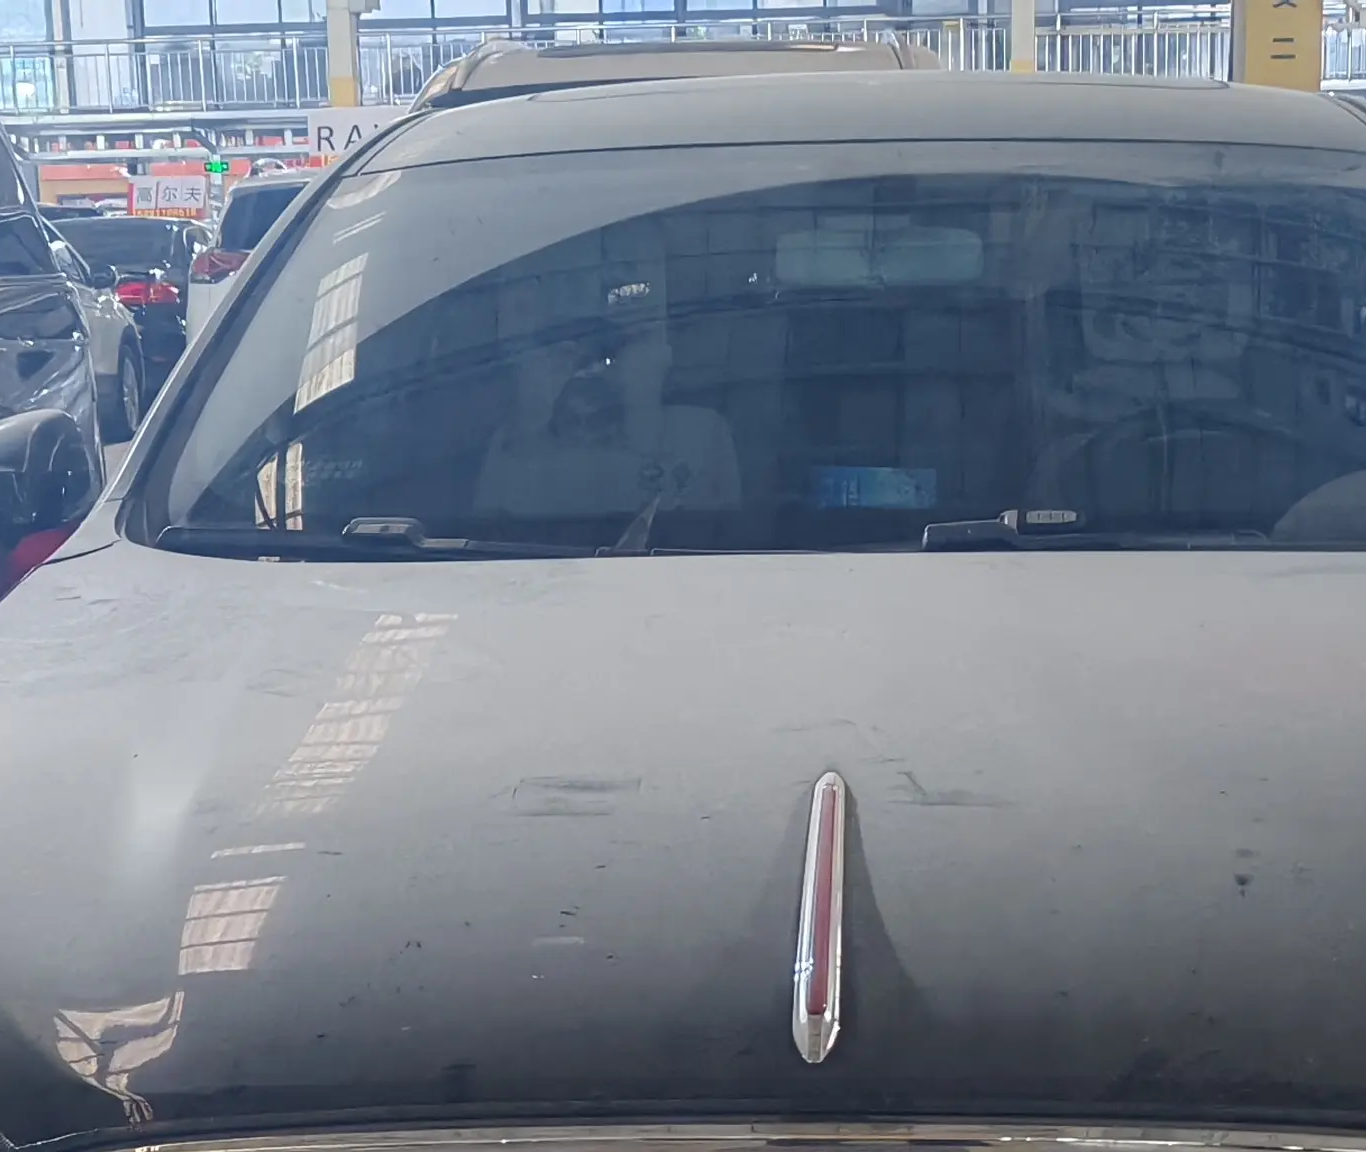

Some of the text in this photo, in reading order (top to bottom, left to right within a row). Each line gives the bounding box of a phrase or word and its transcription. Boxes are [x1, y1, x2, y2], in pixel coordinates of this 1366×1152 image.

[316, 123, 379, 152] RA
[136, 185, 202, 204] 高尔夫
